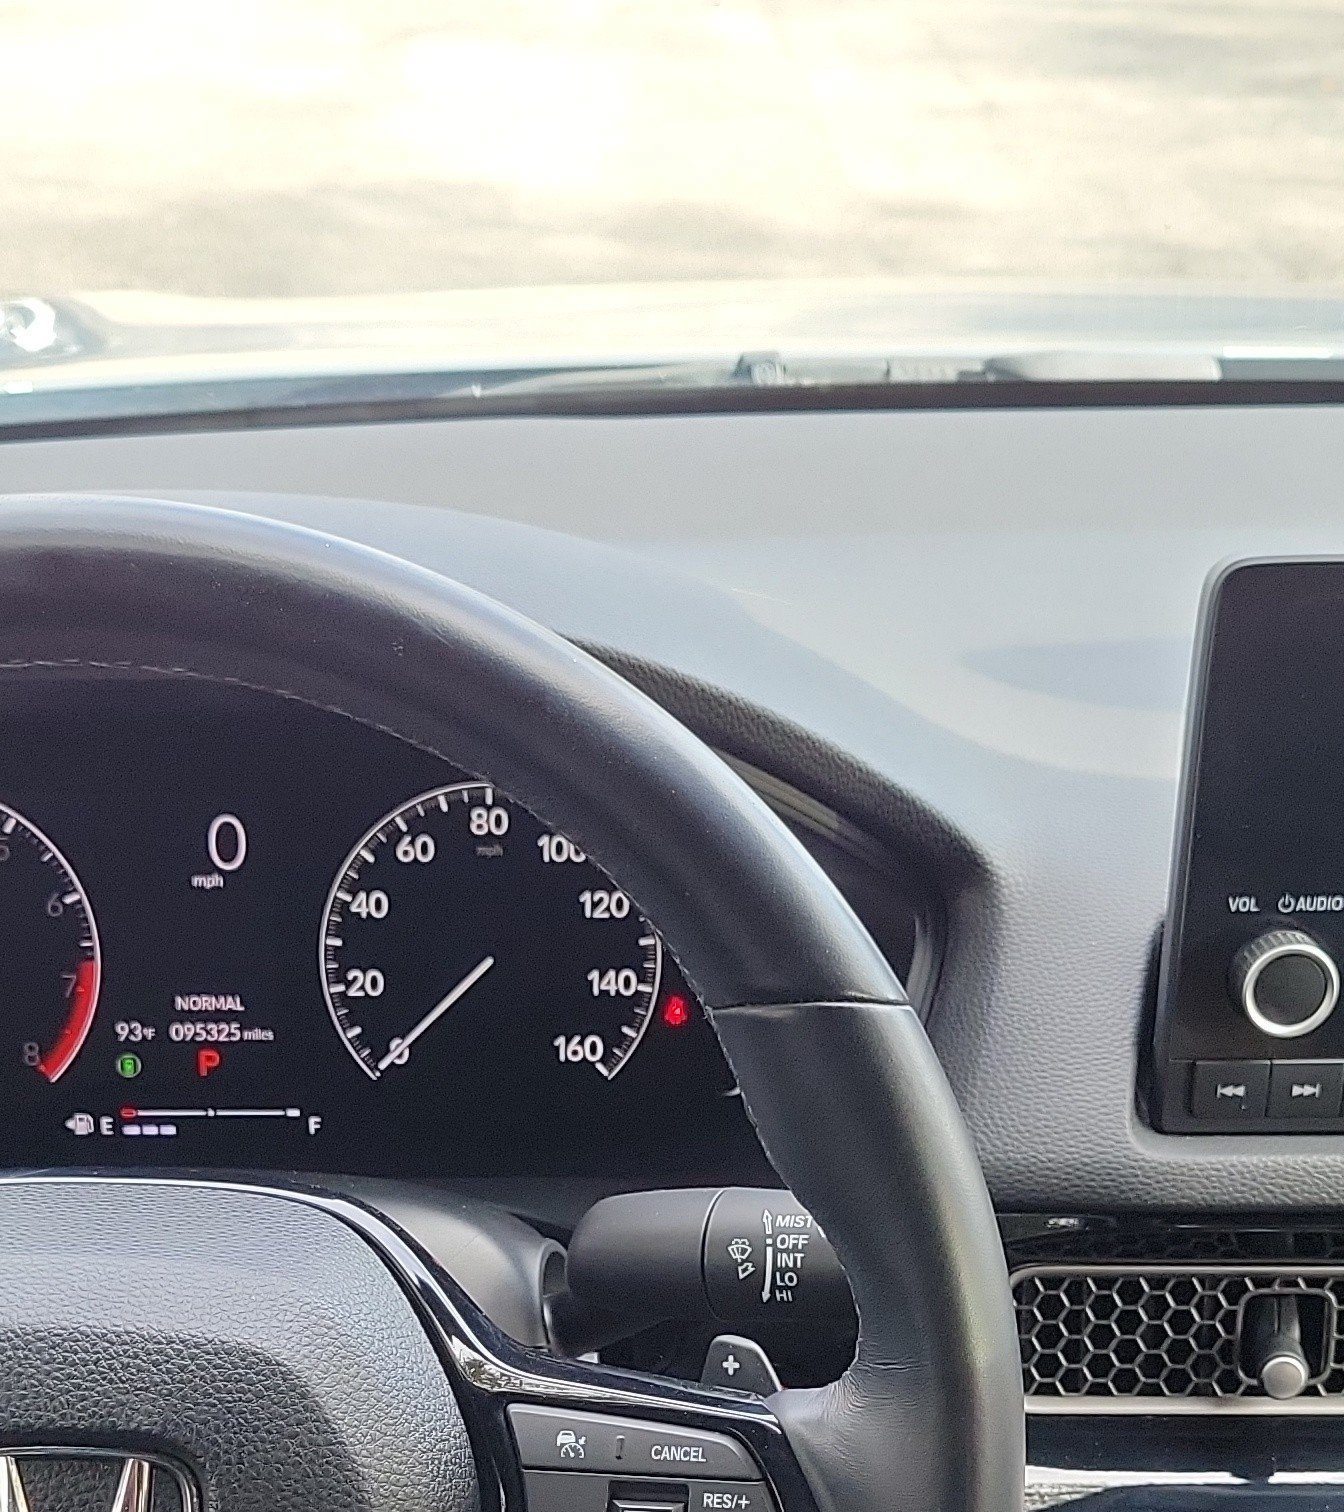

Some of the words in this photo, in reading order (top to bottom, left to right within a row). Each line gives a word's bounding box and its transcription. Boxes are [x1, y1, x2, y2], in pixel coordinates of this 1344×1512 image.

[468, 806, 510, 836] 80
[207, 812, 247, 871] 0
[395, 836, 435, 863] 60
[191, 873, 224, 892] mph
[47, 893, 64, 918] 6
[349, 893, 389, 920] 40
[579, 891, 630, 918] 120
[1228, 895, 1261, 913] VOL
[345, 971, 384, 998] 20
[587, 971, 638, 996] 140
[174, 994, 246, 1012] NORMAL
[168, 1021, 241, 1042] 095325
[242, 1027, 275, 1042] miles
[23, 1042, 41, 1066] 8
[553, 1037, 604, 1064] 160
[197, 1050, 221, 1077] P
[99, 1115, 115, 1136] E
[307, 1115, 322, 1136] F
[776, 1234, 809, 1250] OFF
[776, 1252, 805, 1269] INT
[775, 1270, 798, 1287] LO
[775, 1289, 793, 1302] HI
[651, 1445, 707, 1462] CANCEL
[702, 1492, 751, 1510] RES/+
